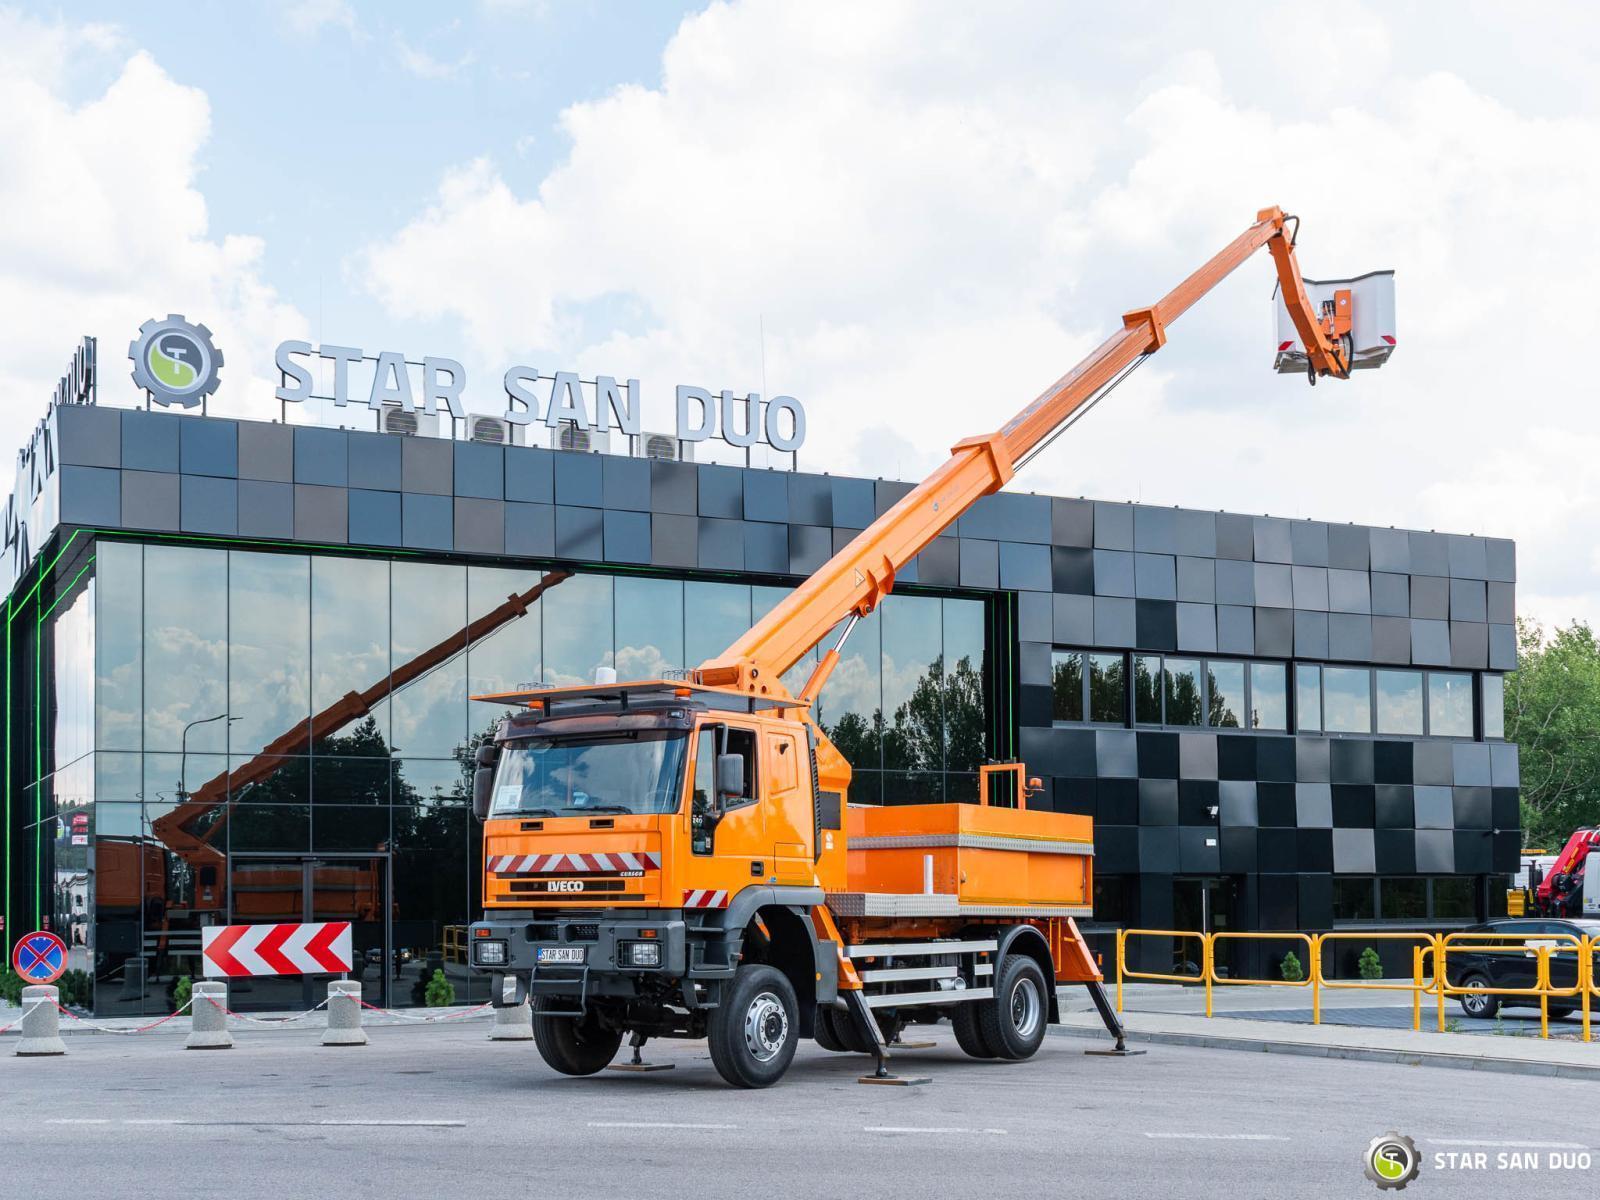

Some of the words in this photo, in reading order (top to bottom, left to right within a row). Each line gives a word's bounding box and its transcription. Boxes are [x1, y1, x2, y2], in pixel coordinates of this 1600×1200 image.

[275, 340, 466, 418] STAR
[504, 365, 641, 436] SAN
[676, 385, 806, 452] DUO
[547, 880, 584, 892] IVECO
[542, 949, 556, 960] STAR
[558, 949, 570, 960] SAN
[572, 949, 584, 960] DUO
